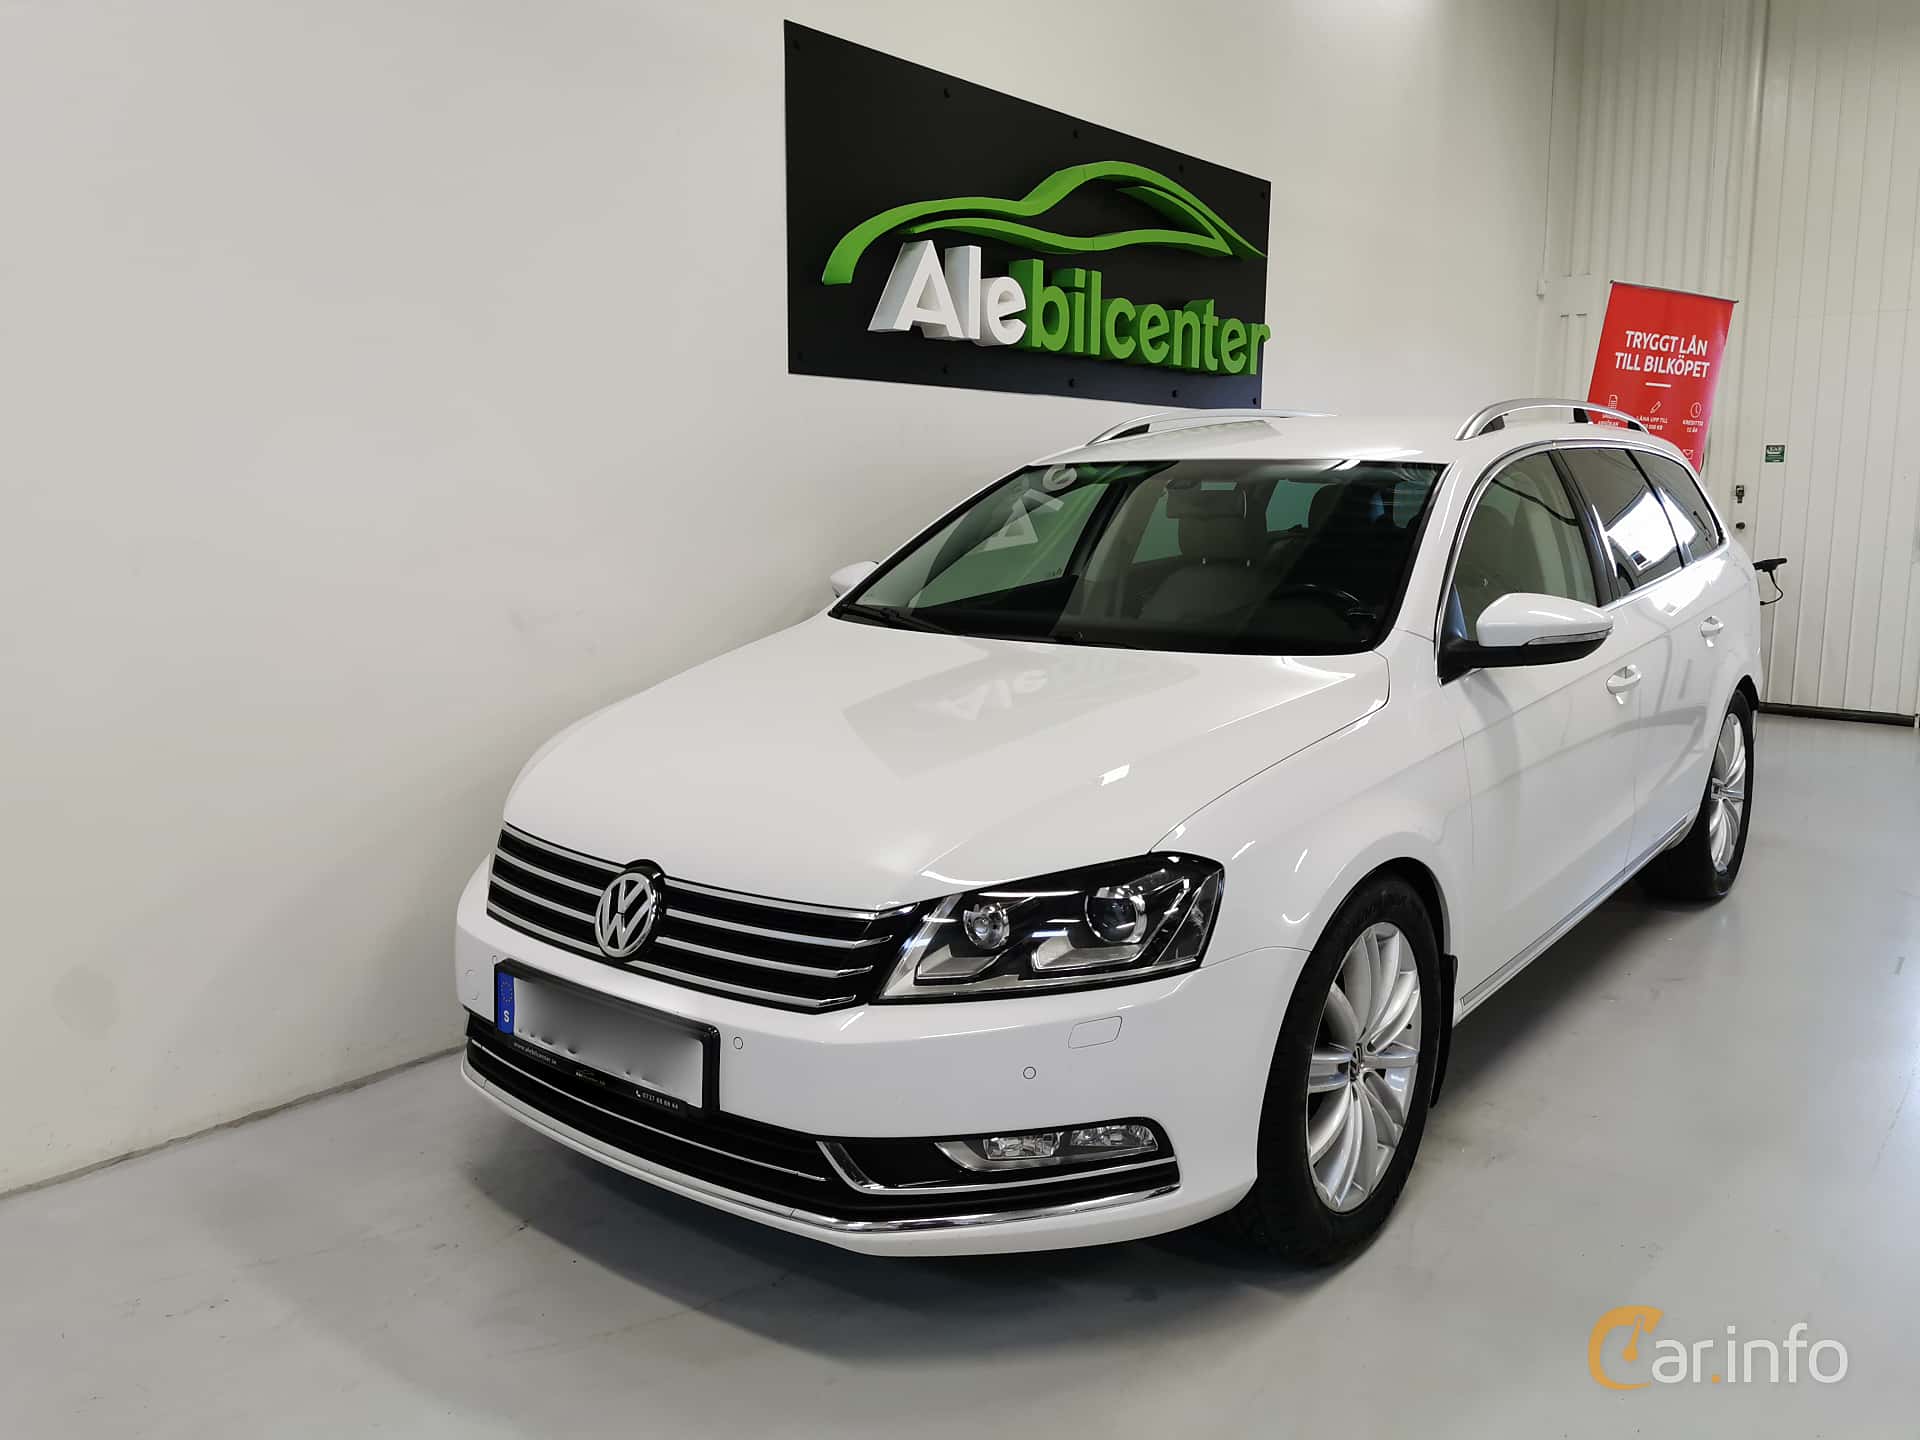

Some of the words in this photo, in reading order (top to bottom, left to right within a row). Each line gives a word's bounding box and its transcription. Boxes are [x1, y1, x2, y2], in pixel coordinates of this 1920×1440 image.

[868, 240, 1270, 375] Alebilcenter
[1625, 330, 1679, 353] TRYGGT
[1679, 335, 1709, 357] LÅN
[1615, 352, 1641, 371] TILL
[1644, 355, 1710, 378] BILKÖPET
[503, 1010, 510, 1023] S
